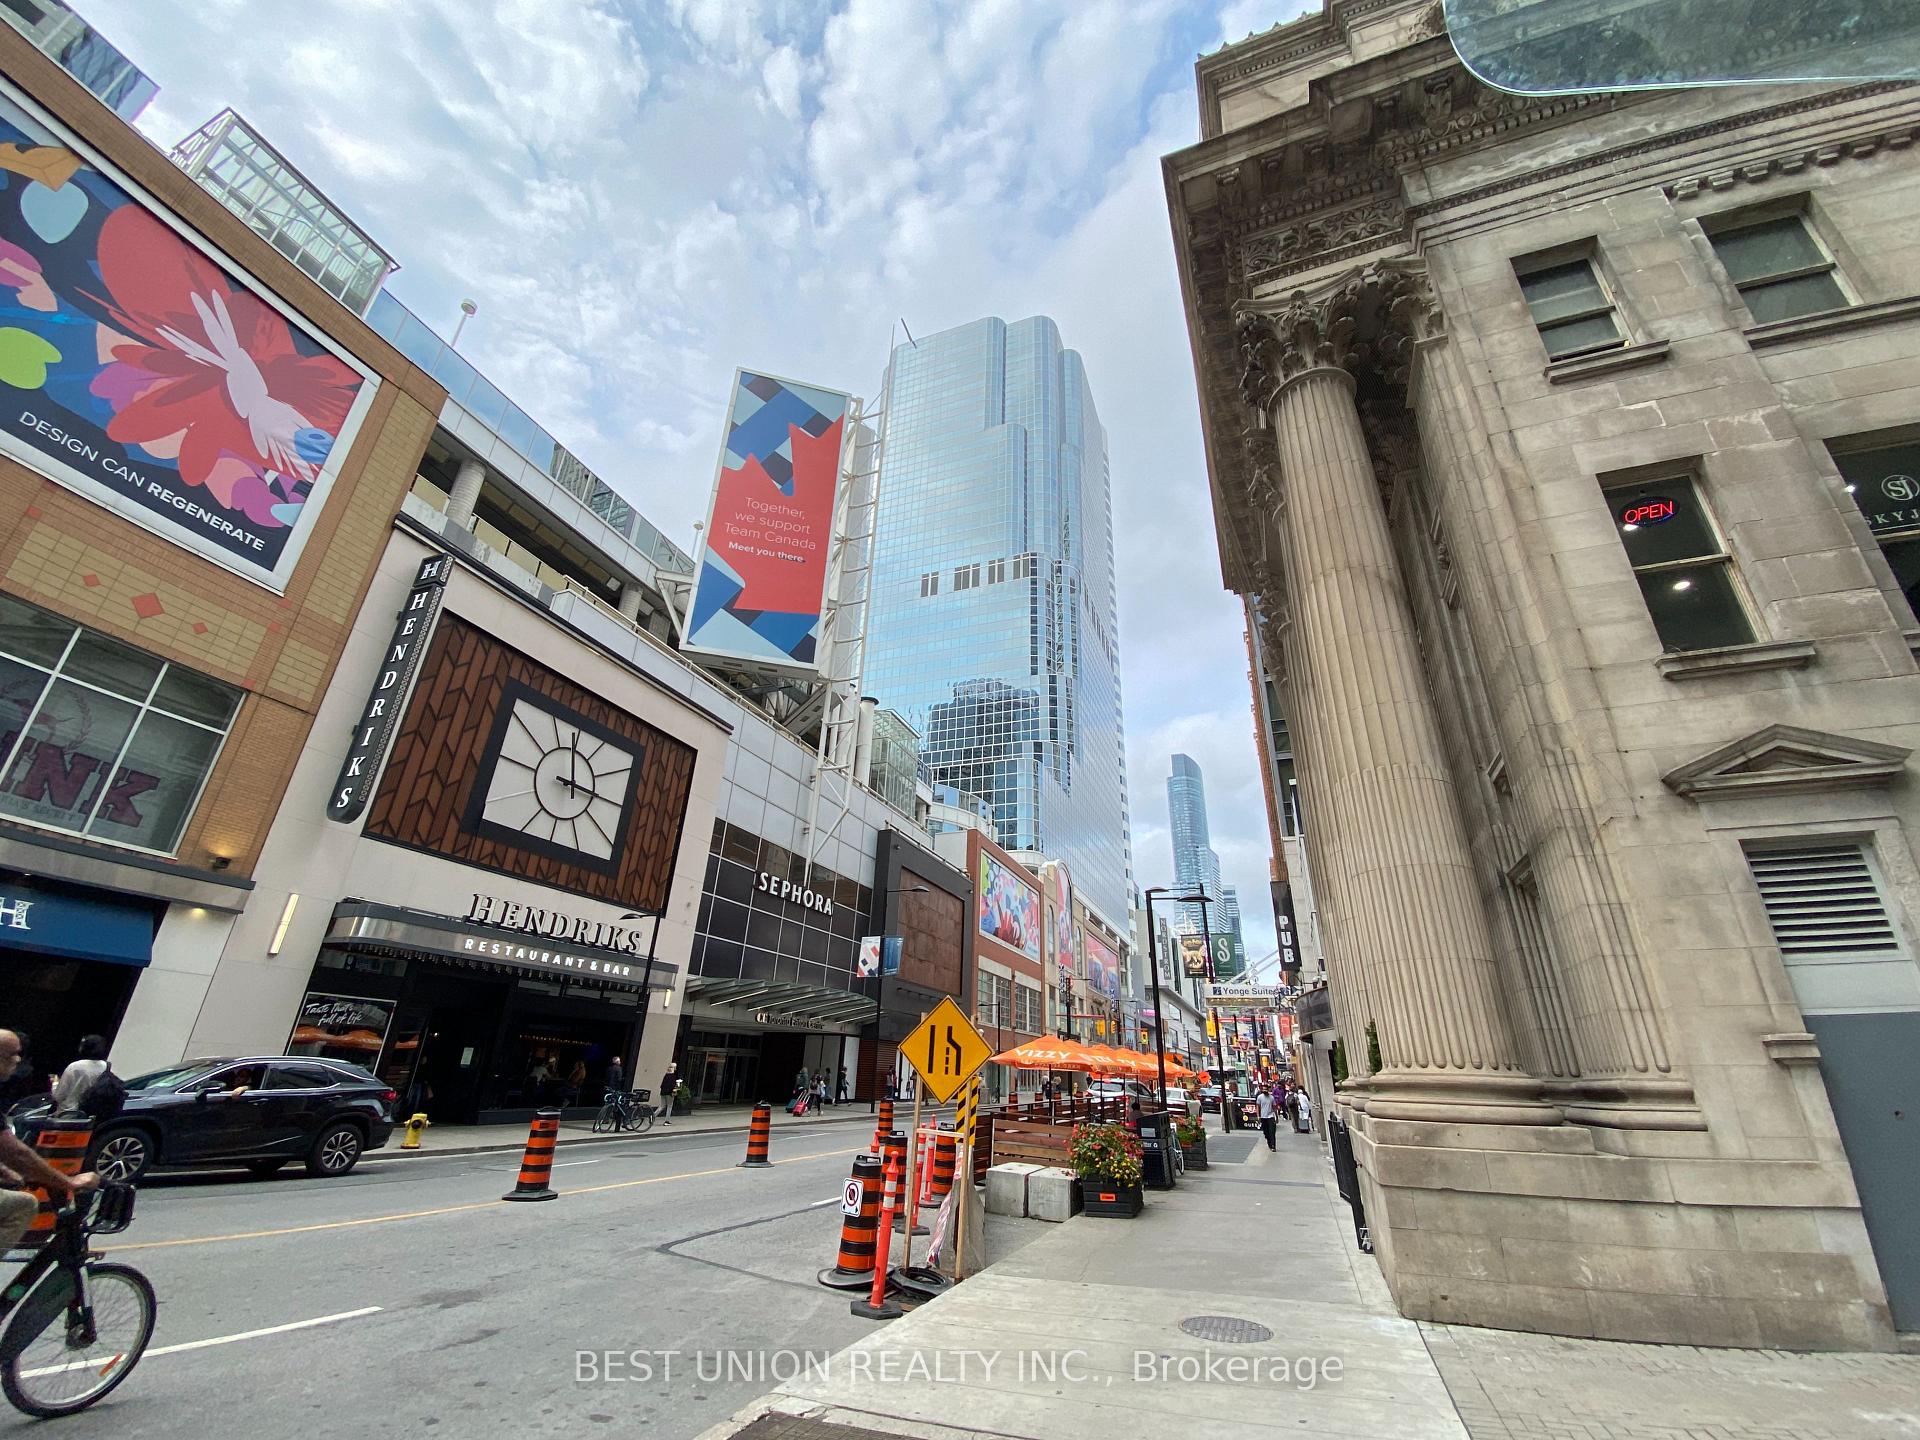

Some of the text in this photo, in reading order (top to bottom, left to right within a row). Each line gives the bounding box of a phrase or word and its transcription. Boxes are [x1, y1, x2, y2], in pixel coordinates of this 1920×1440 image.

[18, 411, 265, 552] DESIGN CAN REGENERATE
[745, 497, 805, 520] Together,
[1624, 500, 1674, 524] OPEN
[735, 512, 810, 534] we support
[725, 522, 816, 550] Team Canada
[728, 541, 754, 553] Meet
[420, 560, 442, 580] H
[336, 591, 429, 808] HENDRIKS
[758, 872, 833, 915] SEPHORA
[470, 894, 643, 954] HENDRIKS
[1278, 915, 1295, 963] PUB
[464, 938, 631, 976] RESTAURANT & BAR
[1223, 987, 1249, 996] Yonge
[305, 1003, 333, 1015] Taste
[1016, 1049, 1071, 1060] VIZZY
